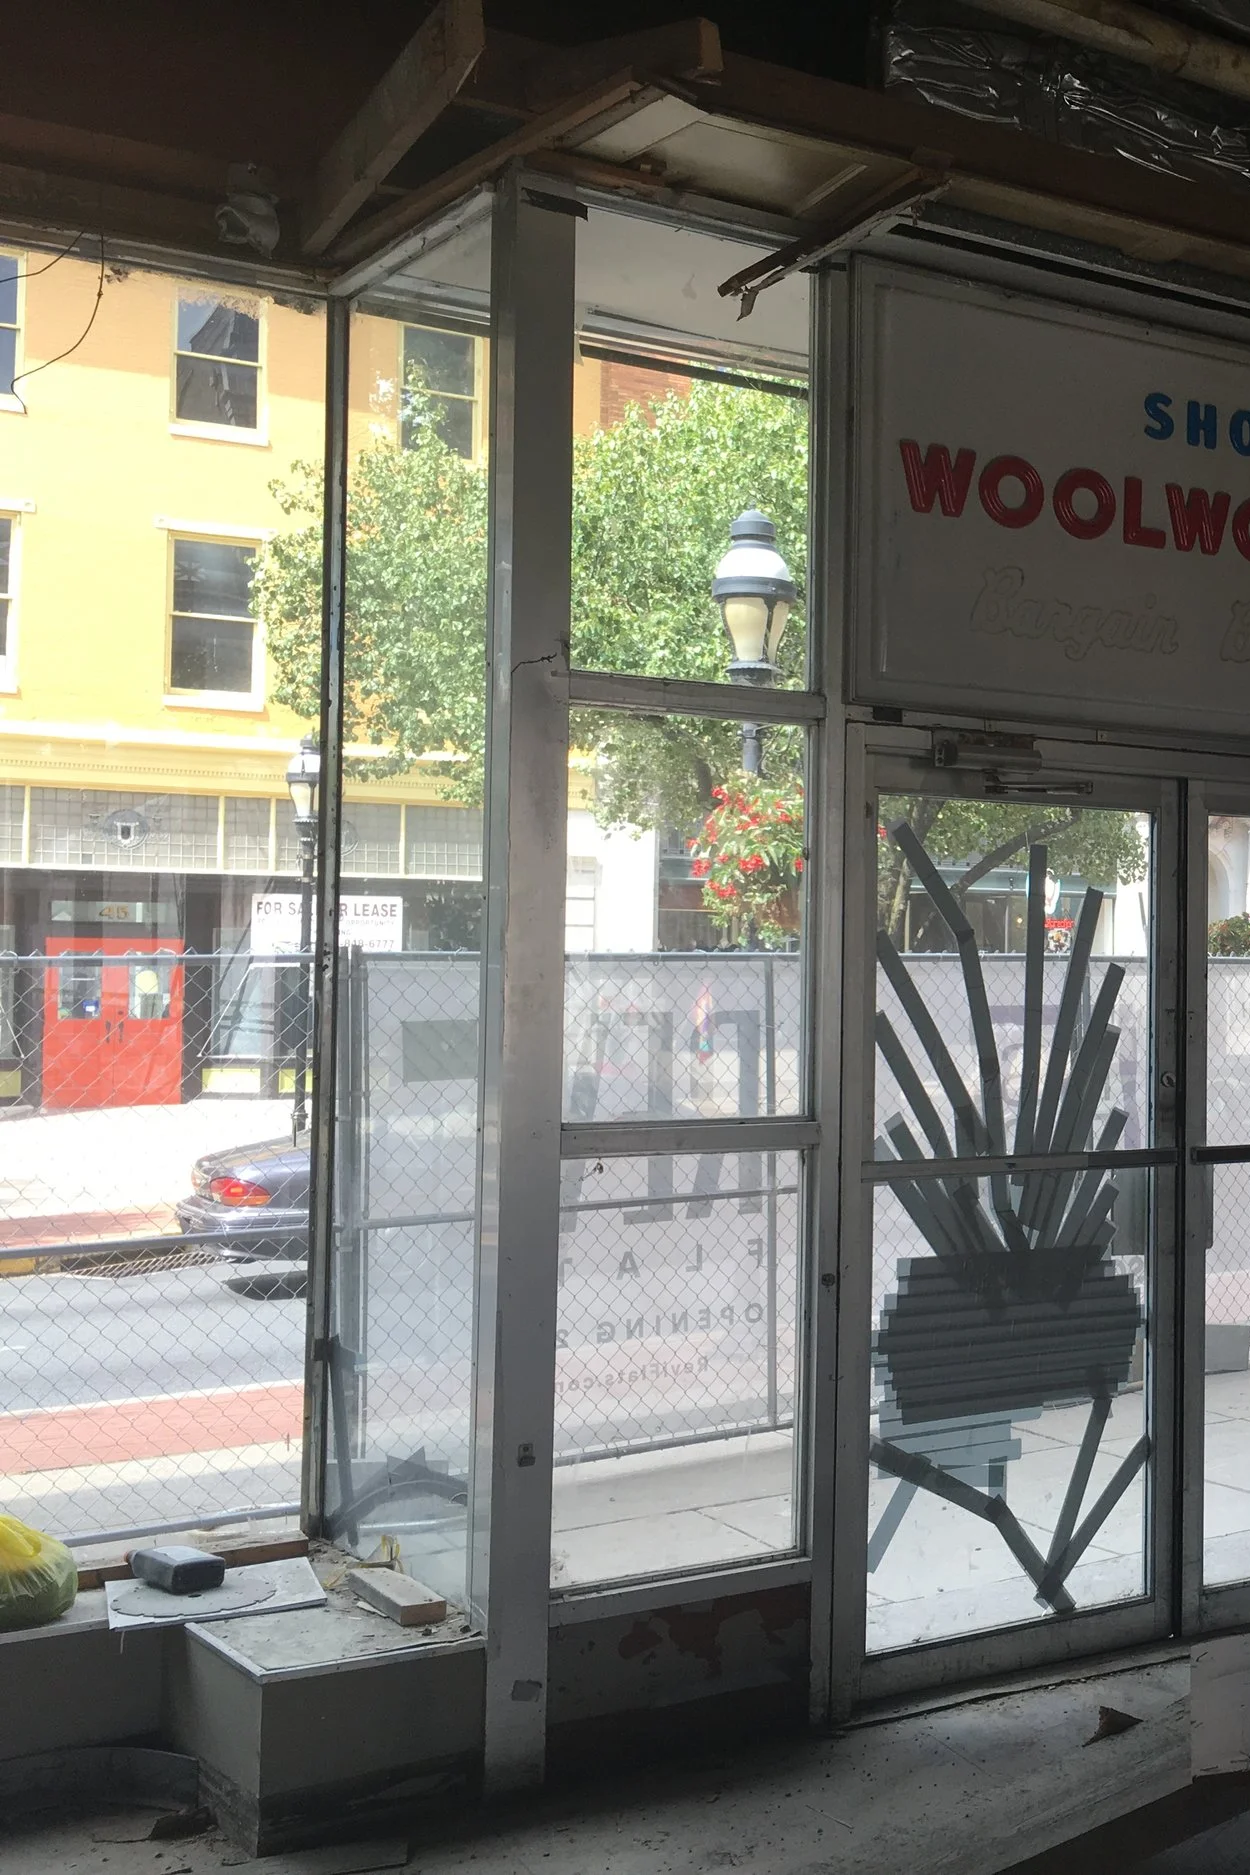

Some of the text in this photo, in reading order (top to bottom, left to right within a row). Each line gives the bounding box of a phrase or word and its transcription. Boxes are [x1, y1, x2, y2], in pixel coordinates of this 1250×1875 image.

[969, 565, 1181, 660] Bargain
[256, 901, 282, 915] FOR
[353, 903, 398, 917] LEASE
